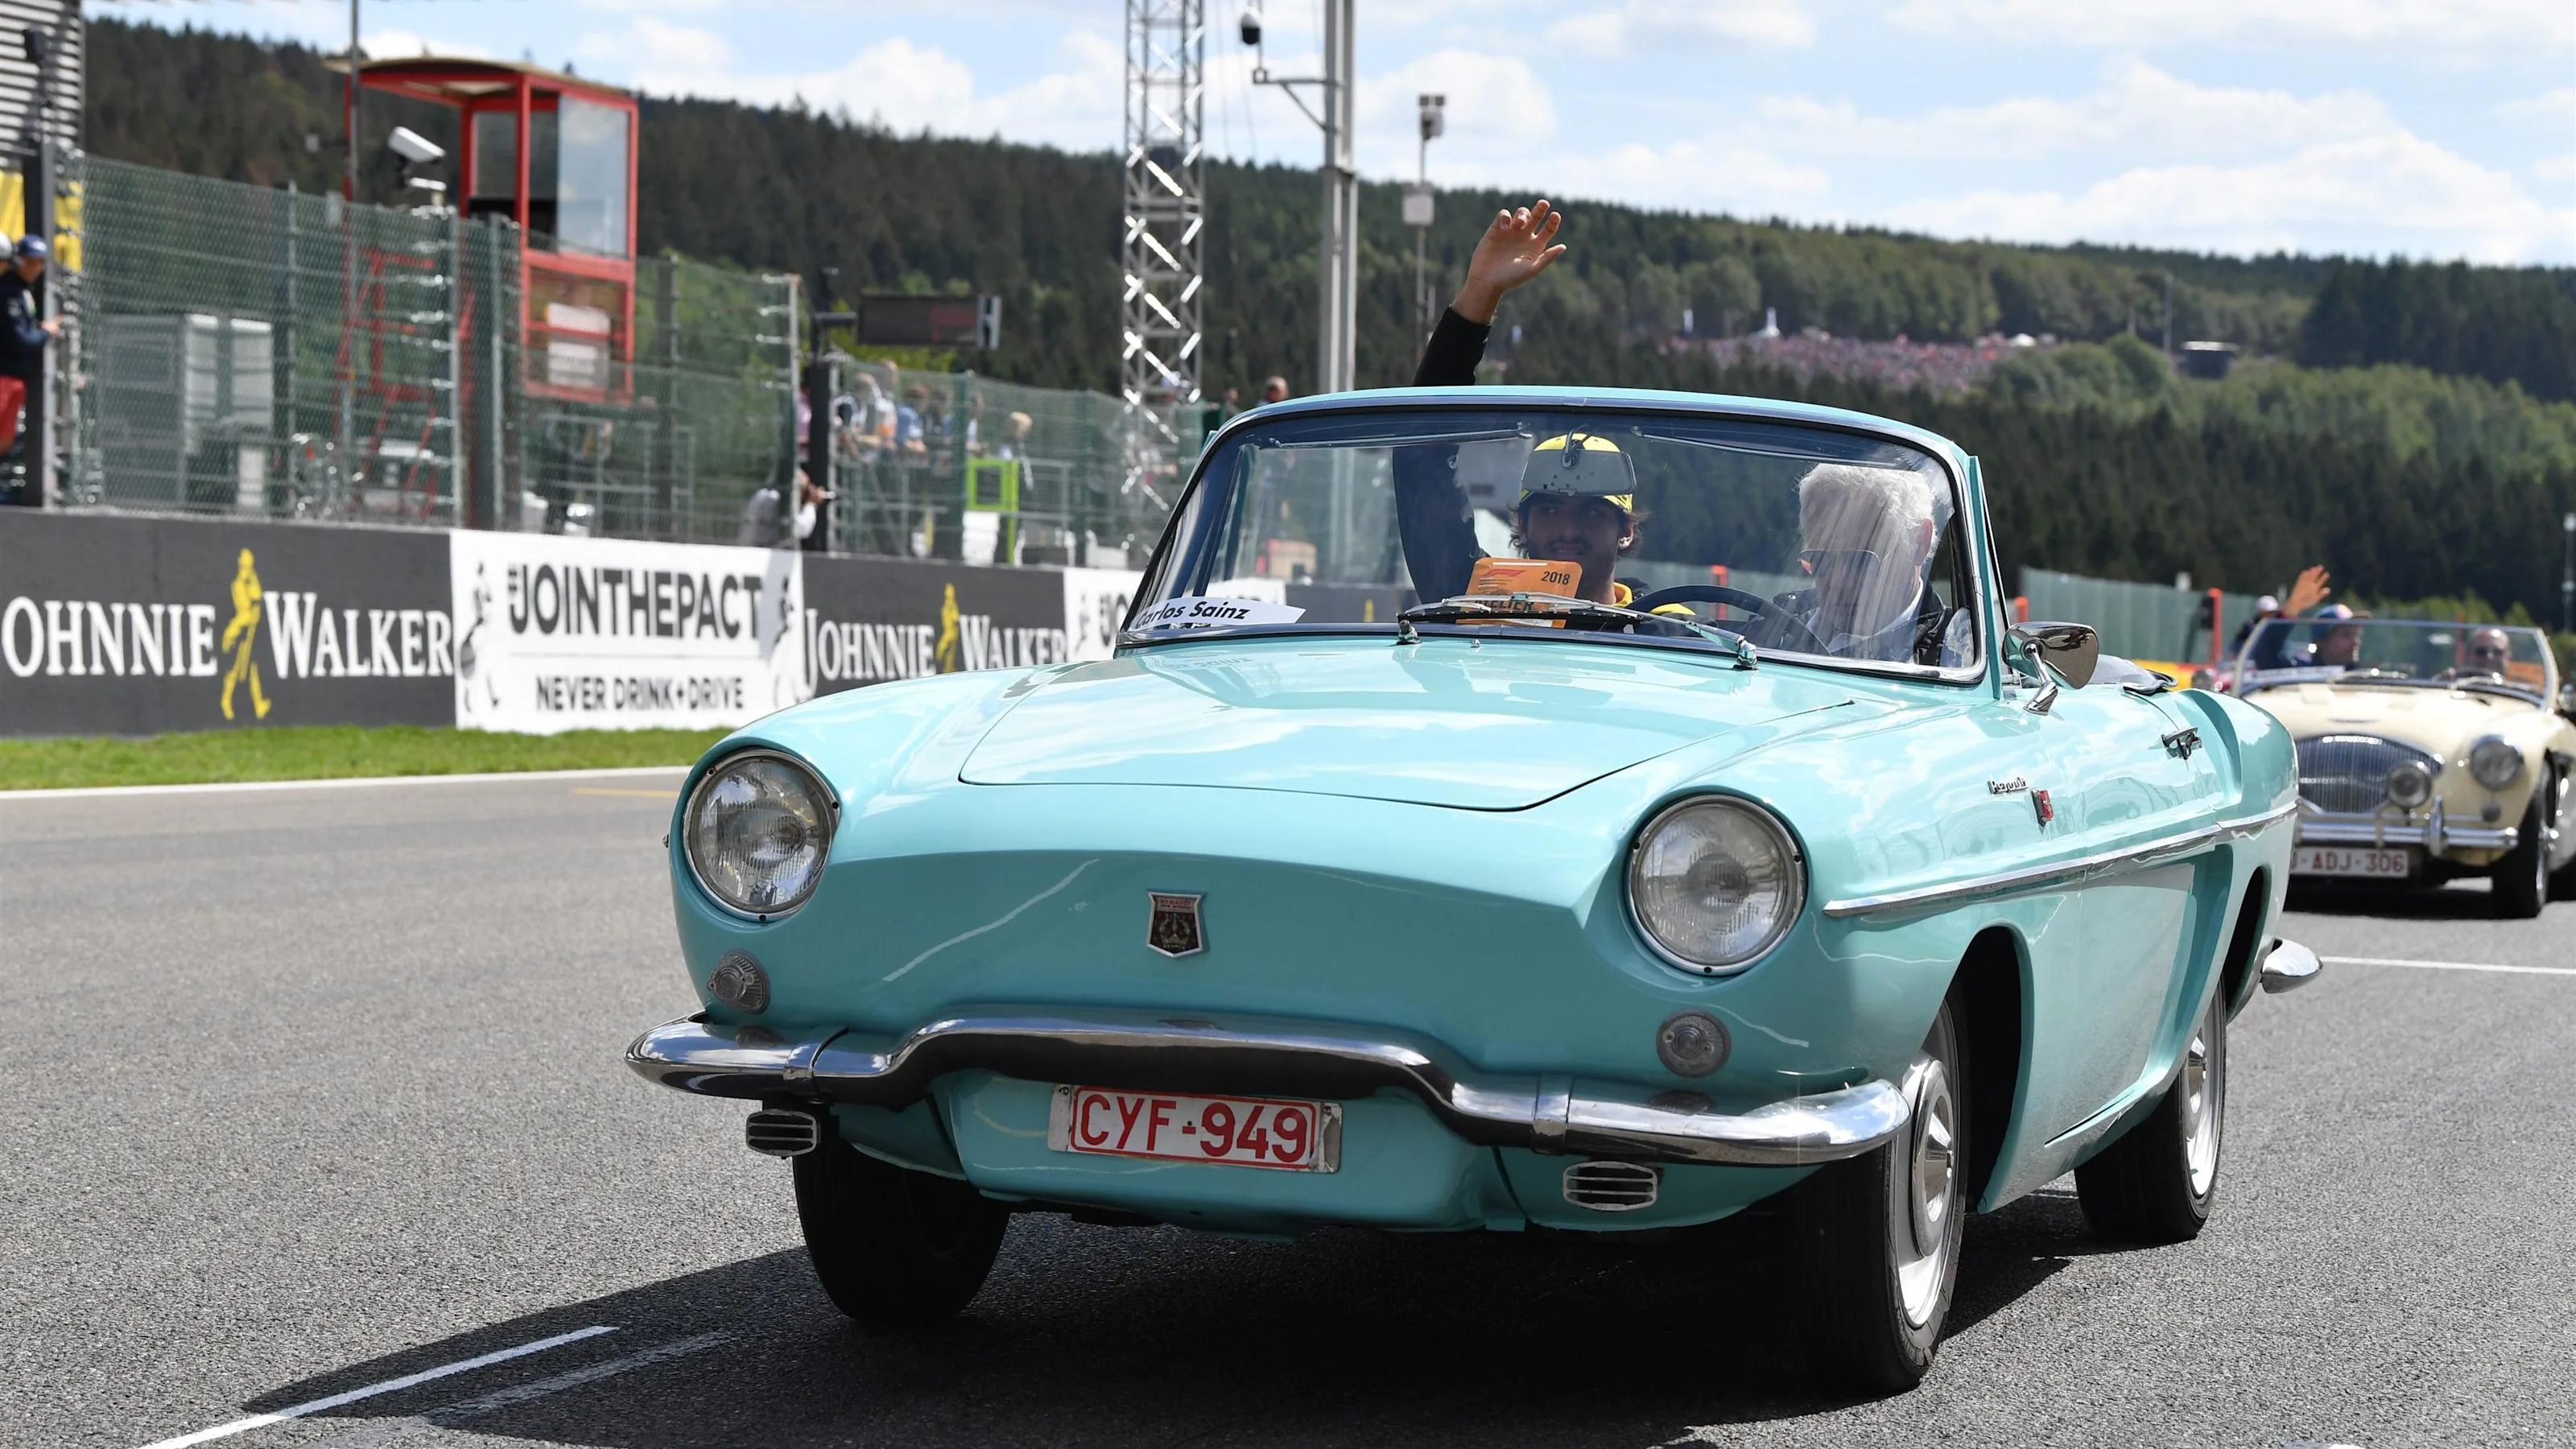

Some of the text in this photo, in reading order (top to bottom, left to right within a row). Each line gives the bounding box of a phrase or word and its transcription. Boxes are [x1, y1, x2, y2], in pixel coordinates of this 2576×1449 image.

[1541, 571, 1571, 585] 2018
[263, 590, 455, 679] WALKER
[1136, 603, 1183, 628] Carlos
[1189, 601, 1251, 621] Sainz
[805, 608, 936, 699] JOHNNIE
[959, 614, 1067, 671] WALKER
[536, 675, 605, 711] NEVER
[1080, 1093, 1308, 1163] CYF-949
